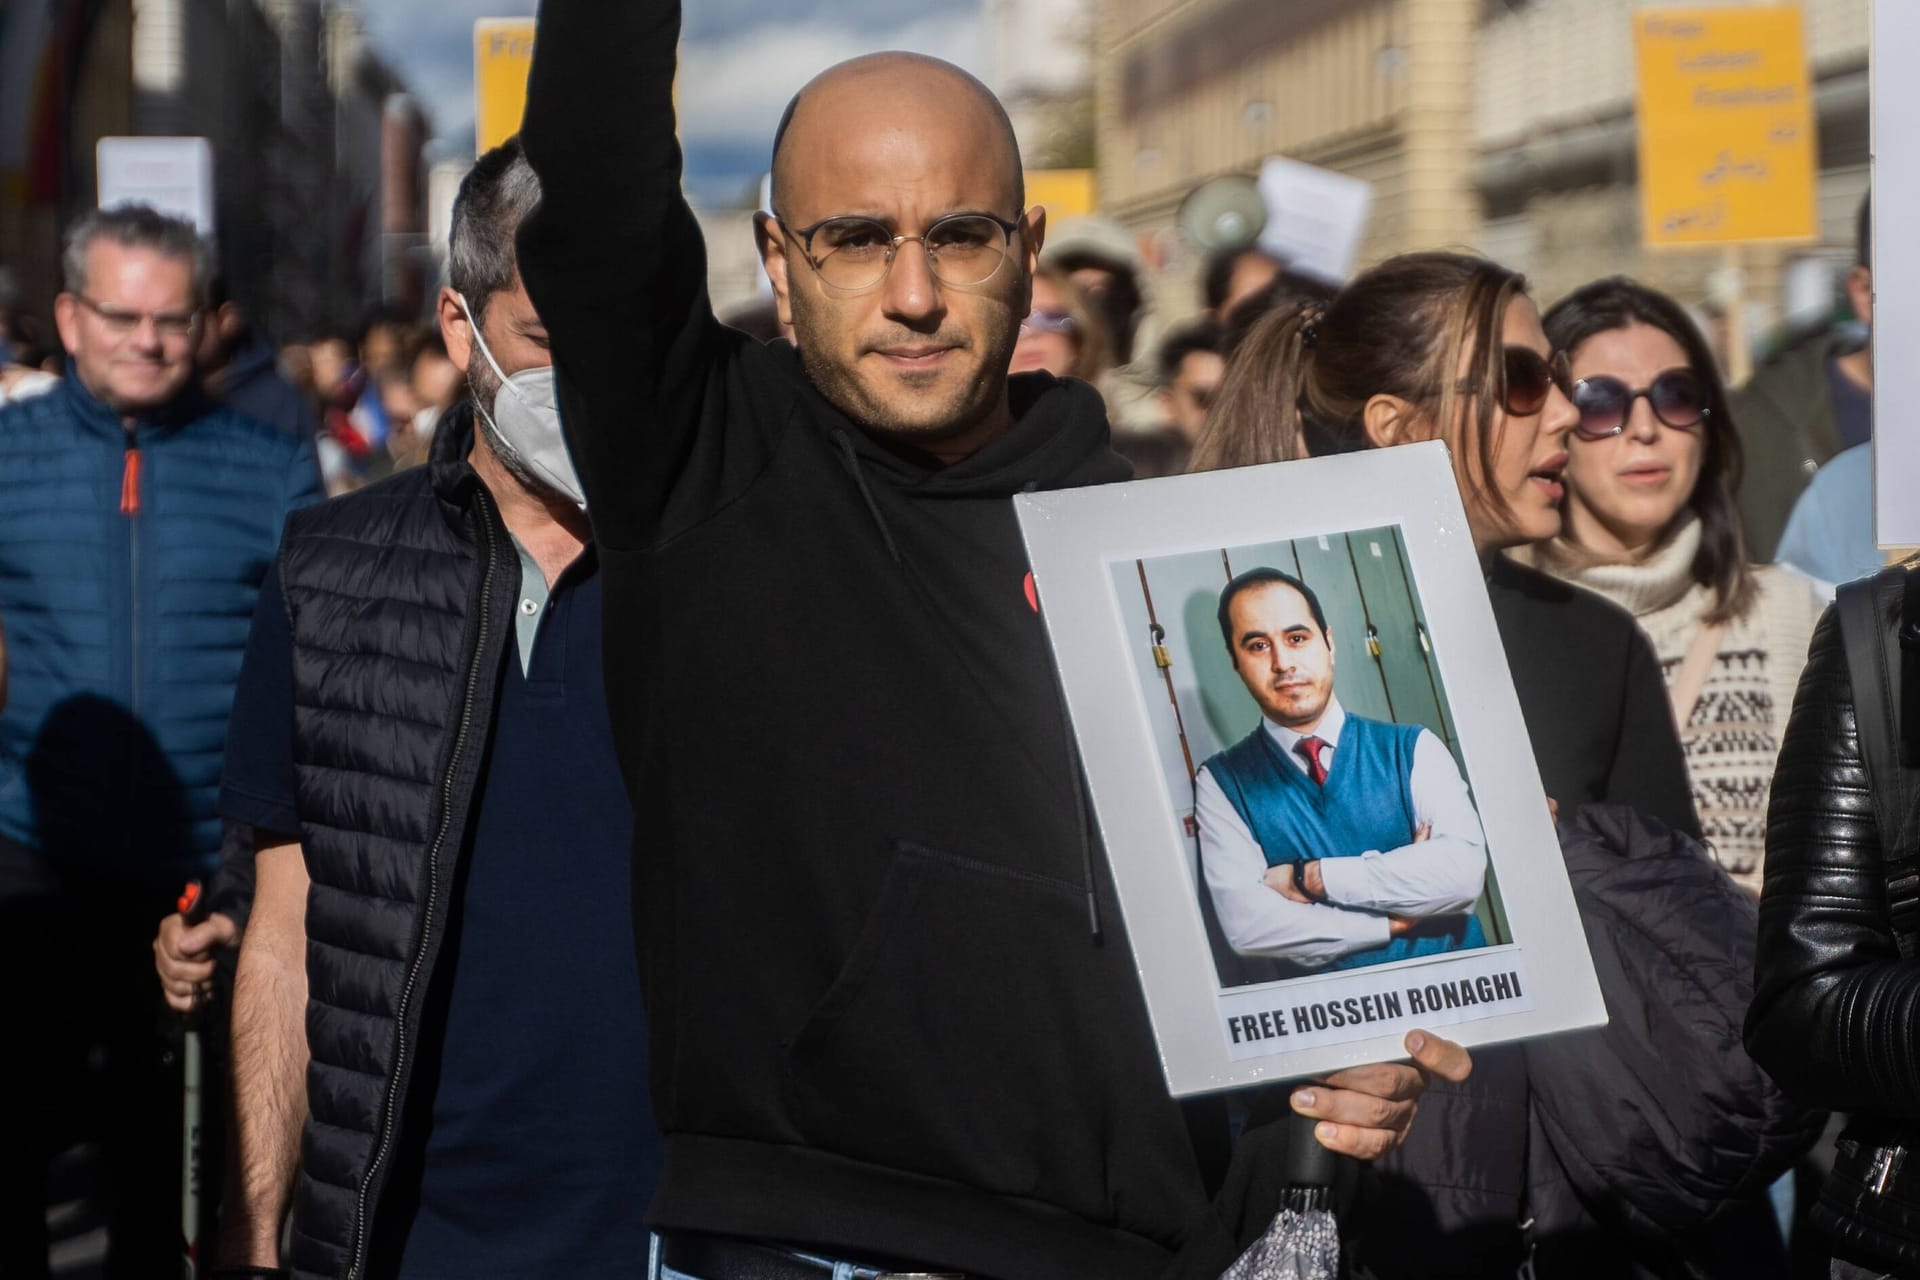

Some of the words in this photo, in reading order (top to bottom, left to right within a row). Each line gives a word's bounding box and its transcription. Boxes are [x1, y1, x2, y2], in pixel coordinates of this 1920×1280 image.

[1228, 1009, 1289, 1044] FREE
[1291, 991, 1403, 1034] HOSSEIN
[1406, 971, 1523, 1015] RONAGHI
